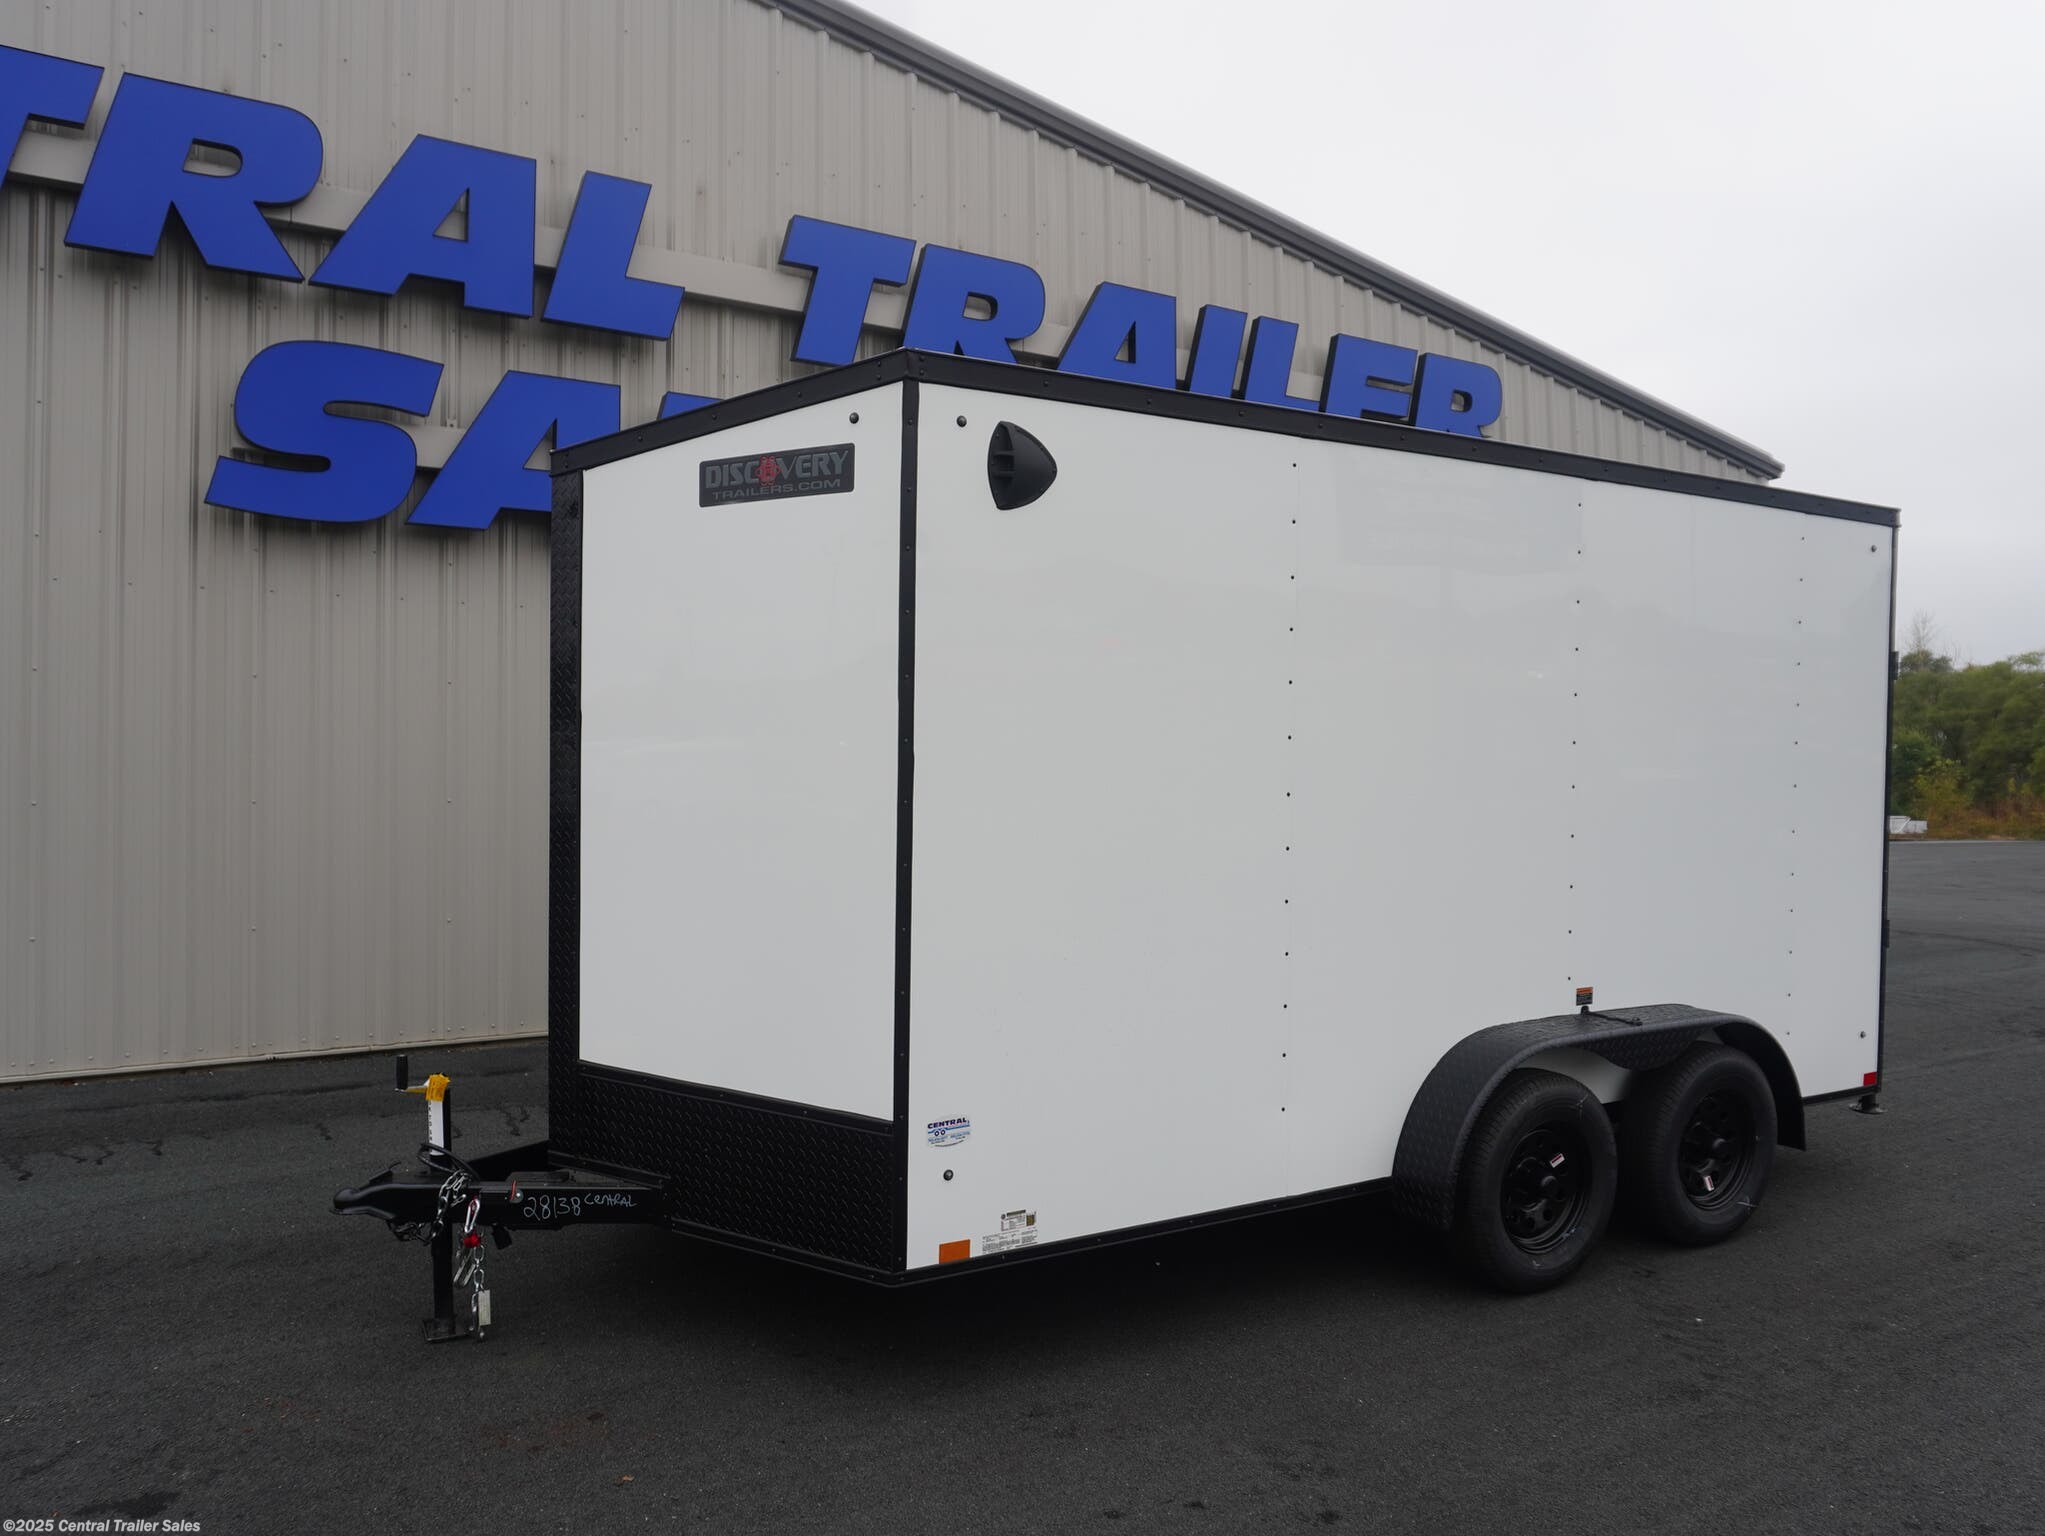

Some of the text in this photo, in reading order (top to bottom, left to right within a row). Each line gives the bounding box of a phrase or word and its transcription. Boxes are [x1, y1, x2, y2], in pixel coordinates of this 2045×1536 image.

[779, 215, 1504, 438] TRAILER
[204, 340, 725, 530] SA
[705, 450, 849, 489] DISCOVERY
[711, 478, 842, 501] TRAILERS.COM
[927, 1117, 967, 1129] CENTRAL
[523, 1194, 581, 1221] 28138
